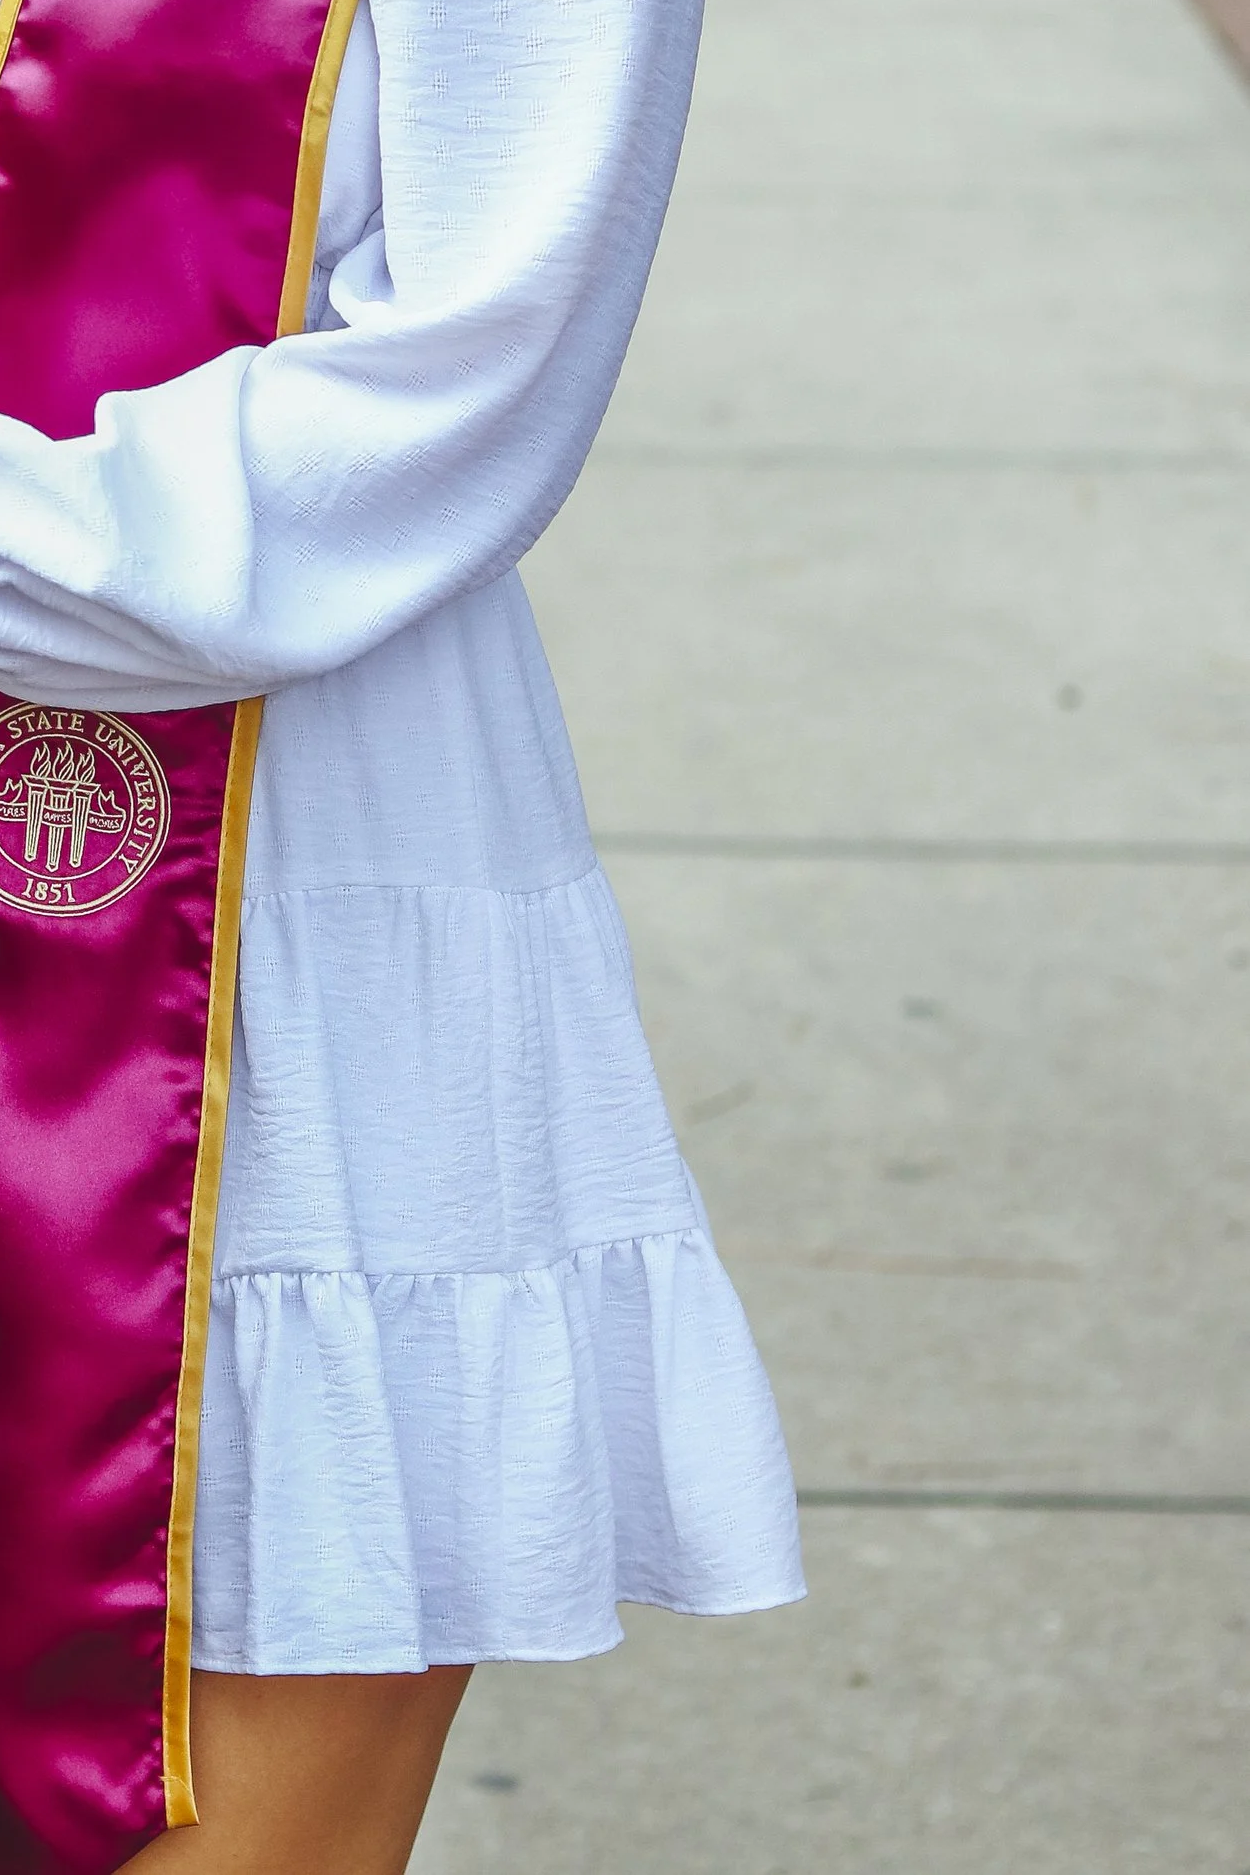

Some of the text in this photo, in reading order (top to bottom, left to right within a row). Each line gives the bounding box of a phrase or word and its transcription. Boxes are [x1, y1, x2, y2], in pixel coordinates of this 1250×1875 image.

[7, 711, 86, 739] STATE
[94, 722, 156, 874] UNIVERSITY
[21, 878, 76, 904] 1851
